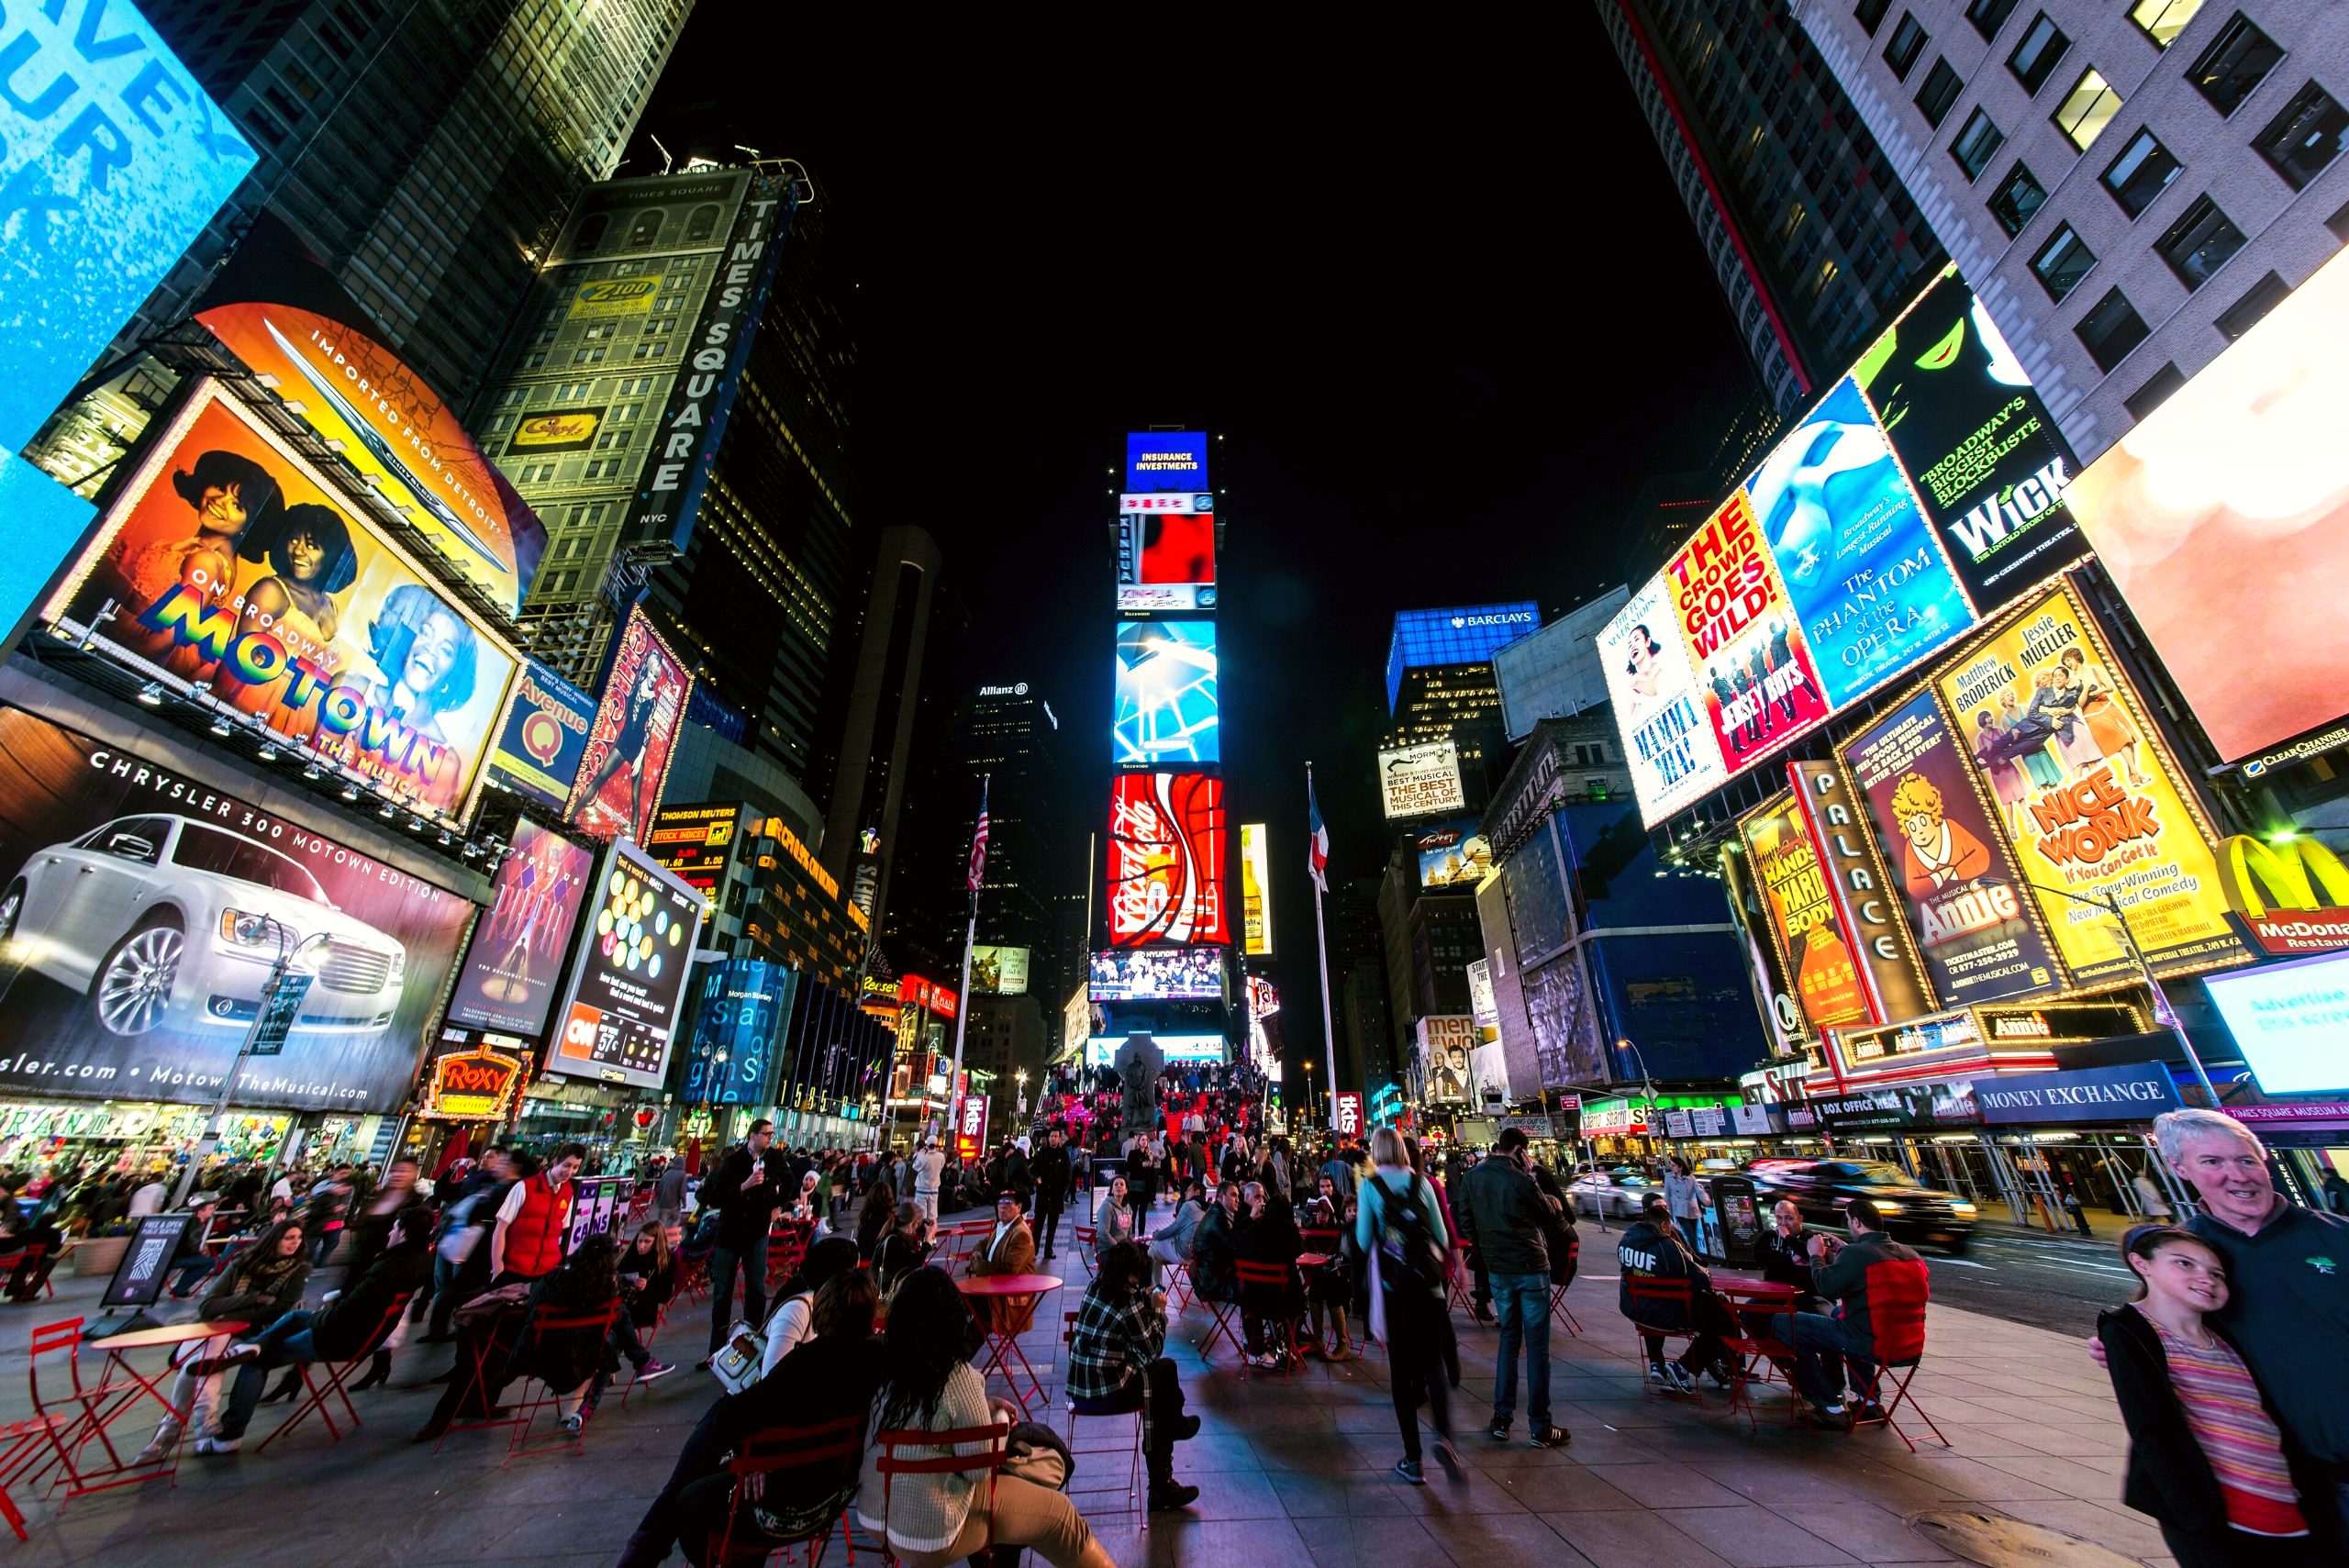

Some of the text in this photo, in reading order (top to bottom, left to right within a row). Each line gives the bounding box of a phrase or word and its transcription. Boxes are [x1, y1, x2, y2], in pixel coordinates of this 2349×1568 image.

[629, 185, 722, 200] TIMES SQUARE
[588, 282, 650, 302] Z100
[651, 199, 777, 492] TIMES SQUARE
[311, 329, 399, 425] IMPORTED
[403, 427, 441, 472] FROM
[1136, 462, 1198, 471] INVESTMENTS
[1141, 452, 1193, 462] INSURANCE
[1930, 435, 1995, 494] BIGGEST
[385, 452, 434, 502] CHRYSLER
[1952, 467, 1996, 503] New York Times
[640, 513, 668, 524] NYC
[1836, 496, 1909, 560] Longest-Running
[1842, 495, 1891, 539] Broadway's
[1974, 504, 2059, 564] THE UNTOLD STORY OF
[1859, 523, 1893, 558] Musical
[1999, 527, 2075, 576] GERSHWIN THEATRE,
[1679, 531, 1756, 612] CROWD
[1842, 567, 1875, 595] The
[1686, 551, 1765, 635] GOES
[1812, 545, 1933, 644] PHANTOM
[191, 569, 338, 669] ON BROADWAY
[1467, 612, 1531, 627] BARCLAYS
[1854, 598, 1896, 635] of the
[2022, 615, 2055, 648] Jessie
[1842, 606, 1927, 667] OPERA
[1902, 645, 1915, 657] 247
[2020, 622, 2077, 670] MUELLER
[138, 583, 447, 785] MOTOWN
[540, 673, 578, 705] BEST MUSICAL
[1955, 662, 2017, 714] BRODERICK
[1956, 655, 1998, 690] Matthew
[518, 675, 588, 735] Avenue
[979, 685, 1014, 696] Allianz
[1720, 683, 1767, 736] JERSEY
[1764, 658, 1805, 705] BOYS
[579, 621, 648, 806] CHICAGO
[1633, 695, 1699, 764] MAMMA
[1877, 714, 1918, 748] ULTIMATE
[318, 734, 355, 766] THE
[522, 710, 563, 768] Q
[1855, 745, 1900, 775] FEEL-GOOD
[1898, 716, 1936, 751] MUSICAL
[1871, 762, 1880, 773] IS
[1878, 747, 1904, 769] BACK
[1902, 734, 1923, 755] AND
[1386, 771, 1410, 779] WINNER
[1430, 765, 1453, 773] AWARDS
[1387, 771, 1454, 787] BEST MUSICAL
[1653, 737, 1697, 790] MIA!
[1863, 771, 1891, 791] BETTER
[1888, 753, 1916, 777] THAN
[1389, 787, 1457, 806] MUSICAL OF
[1419, 777, 1455, 793] BEST
[2030, 766, 2128, 835] NICE
[661, 807, 736, 822] THOMSON REUTERS
[1390, 802, 1412, 812] THIS
[90, 751, 441, 903] CHRYSLER 300 MOTOWN EDITION
[653, 829, 707, 841] STOCK INDICES
[2037, 795, 2160, 868] WORK
[704, 856, 723, 865] 0.00
[1445, 843, 1461, 853] guest
[1763, 841, 1818, 886] HANDS
[2065, 843, 2158, 884] If You Can Get It
[518, 851, 580, 886] JOIN US
[1814, 773, 1899, 961] PALACE
[2092, 863, 2179, 898] Tony-Winning
[1776, 865, 1829, 916] HARD
[1929, 884, 1970, 906] THE MUSICAL
[2068, 877, 2198, 924] New Comedy
[2146, 898, 2191, 918] IRA GERSHWIN
[484, 884, 572, 965] PIPPIN
[1786, 899, 1835, 938] BODY
[1920, 877, 2020, 945] Annie
[2145, 930, 2179, 945] KATHLEEN
[2178, 922, 2212, 938] MARSHALL
[1146, 951, 1179, 959] HYUNDAI
[1944, 938, 2018, 966] TICKETMASTER.COM
[1949, 964, 1959, 974] OR
[2152, 941, 2220, 962] IMPERIAL THEATRE, 249
[863, 976, 898, 994] Reese's
[1476, 972, 1487, 983] THE
[728, 989, 773, 1002] Morgan Stanley
[1427, 1017, 1475, 1035] men
[1429, 1036, 1440, 1045] at
[1996, 1011, 2052, 1039] Annie
[1855, 1038, 1884, 1060] Annie
[1821, 1095, 1902, 1115] BOX OFFICE HERE
[1932, 1097, 1976, 1119] Annie
[1982, 1080, 2165, 1110] MONEY EXCHANGE
[2231, 1106, 2340, 1118] TIMES SQUARE MUSEUM
[964, 1098, 984, 1136] tkts
[1339, 1095, 1359, 1135] tkts
[1606, 1108, 1627, 1127] sbarro
[1788, 1106, 1814, 1126] Annie
